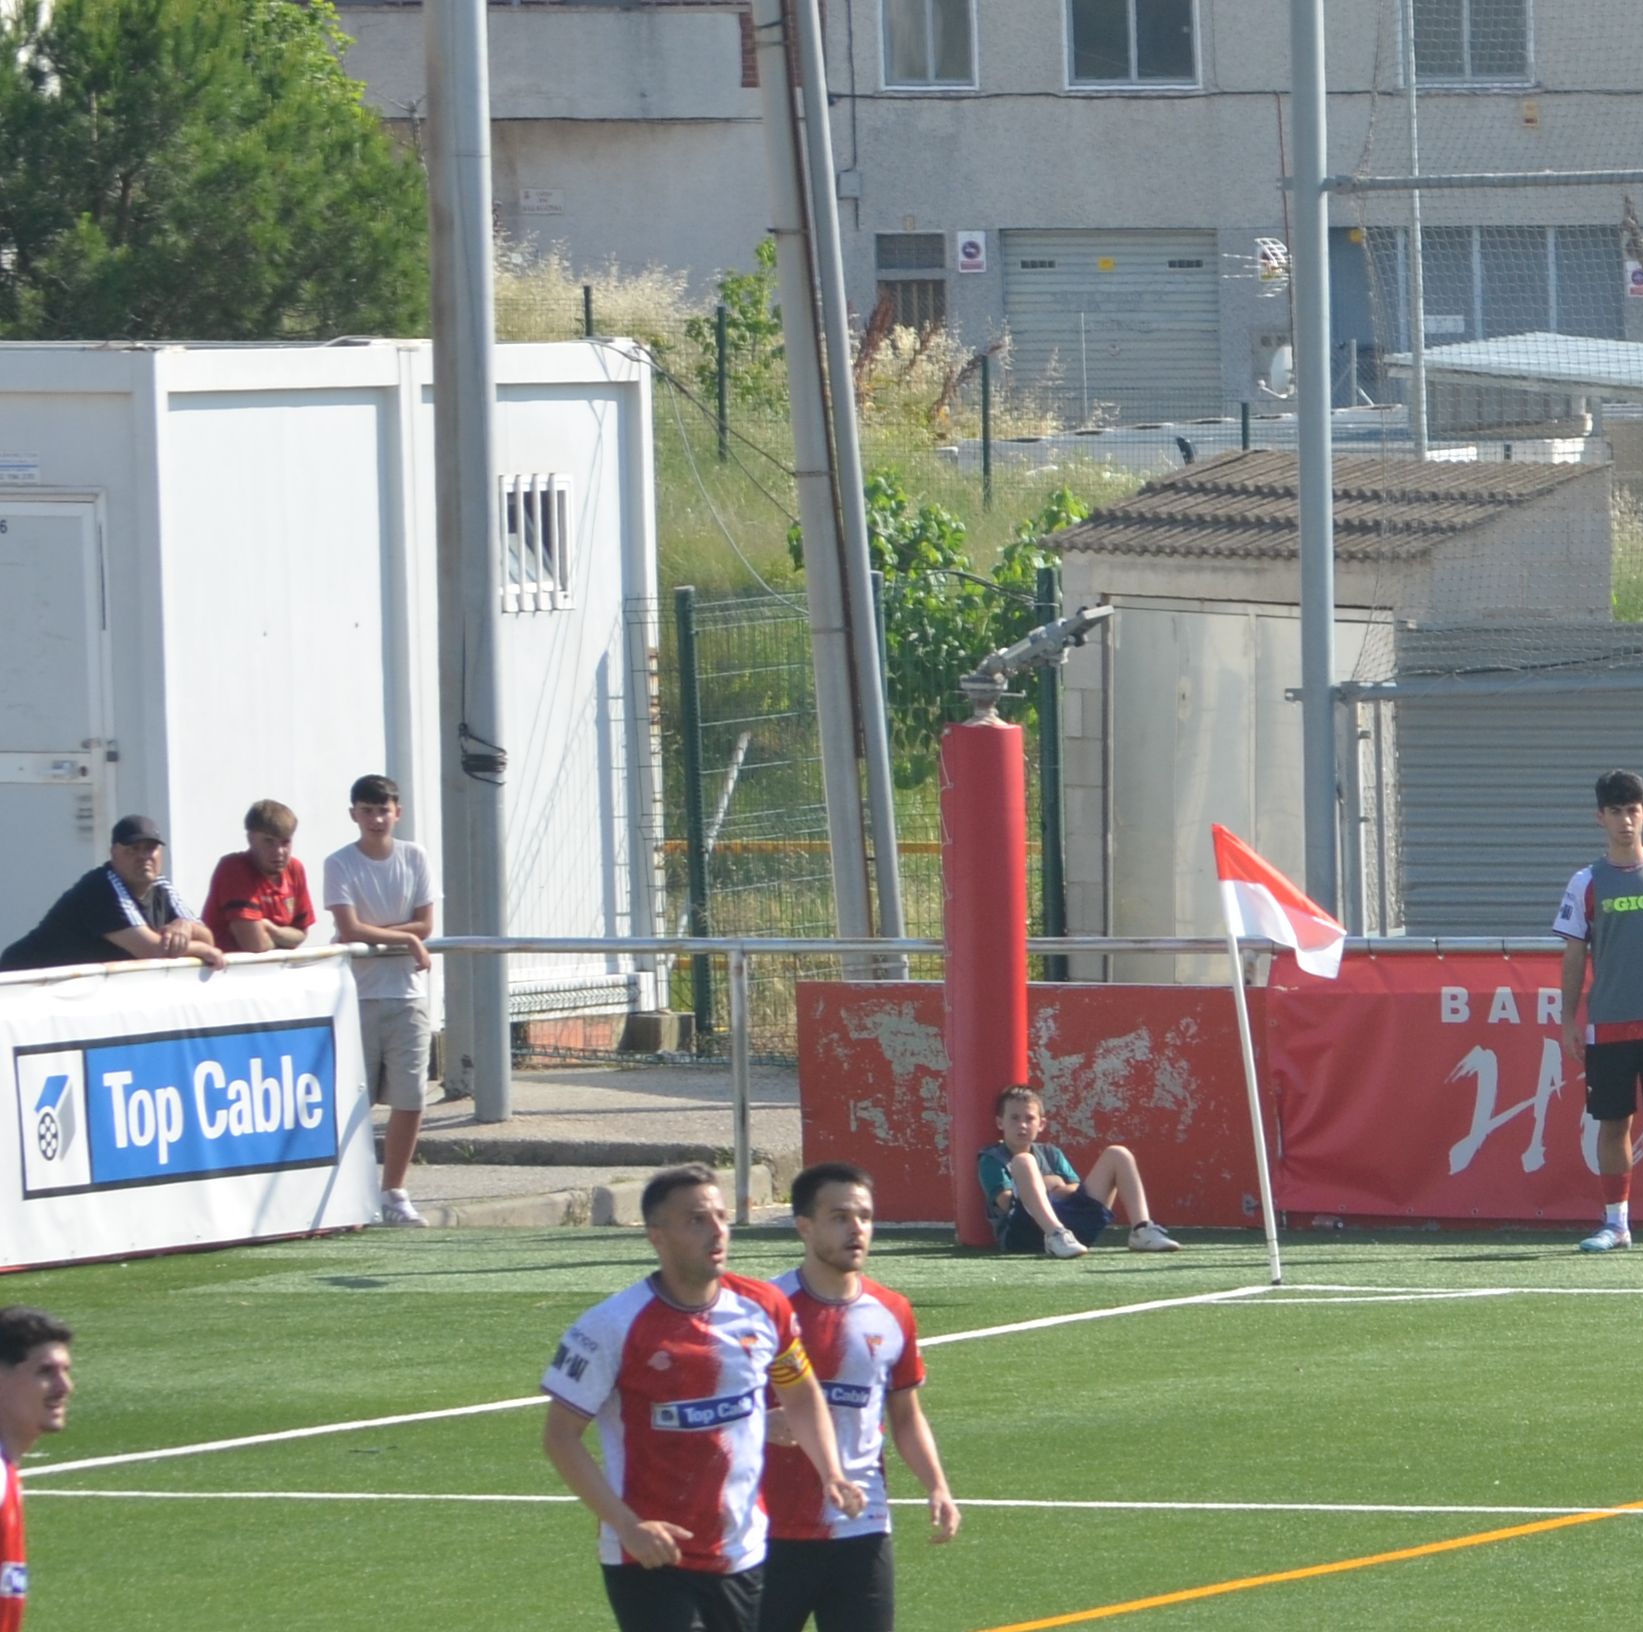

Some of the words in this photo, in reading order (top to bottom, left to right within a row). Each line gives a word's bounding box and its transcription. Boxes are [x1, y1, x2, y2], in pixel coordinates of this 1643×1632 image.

[1440, 986, 1563, 1024] BAR
[103, 1070, 184, 1165] Top
[193, 1055, 323, 1140] Cable
[684, 1406, 715, 1425] Top
